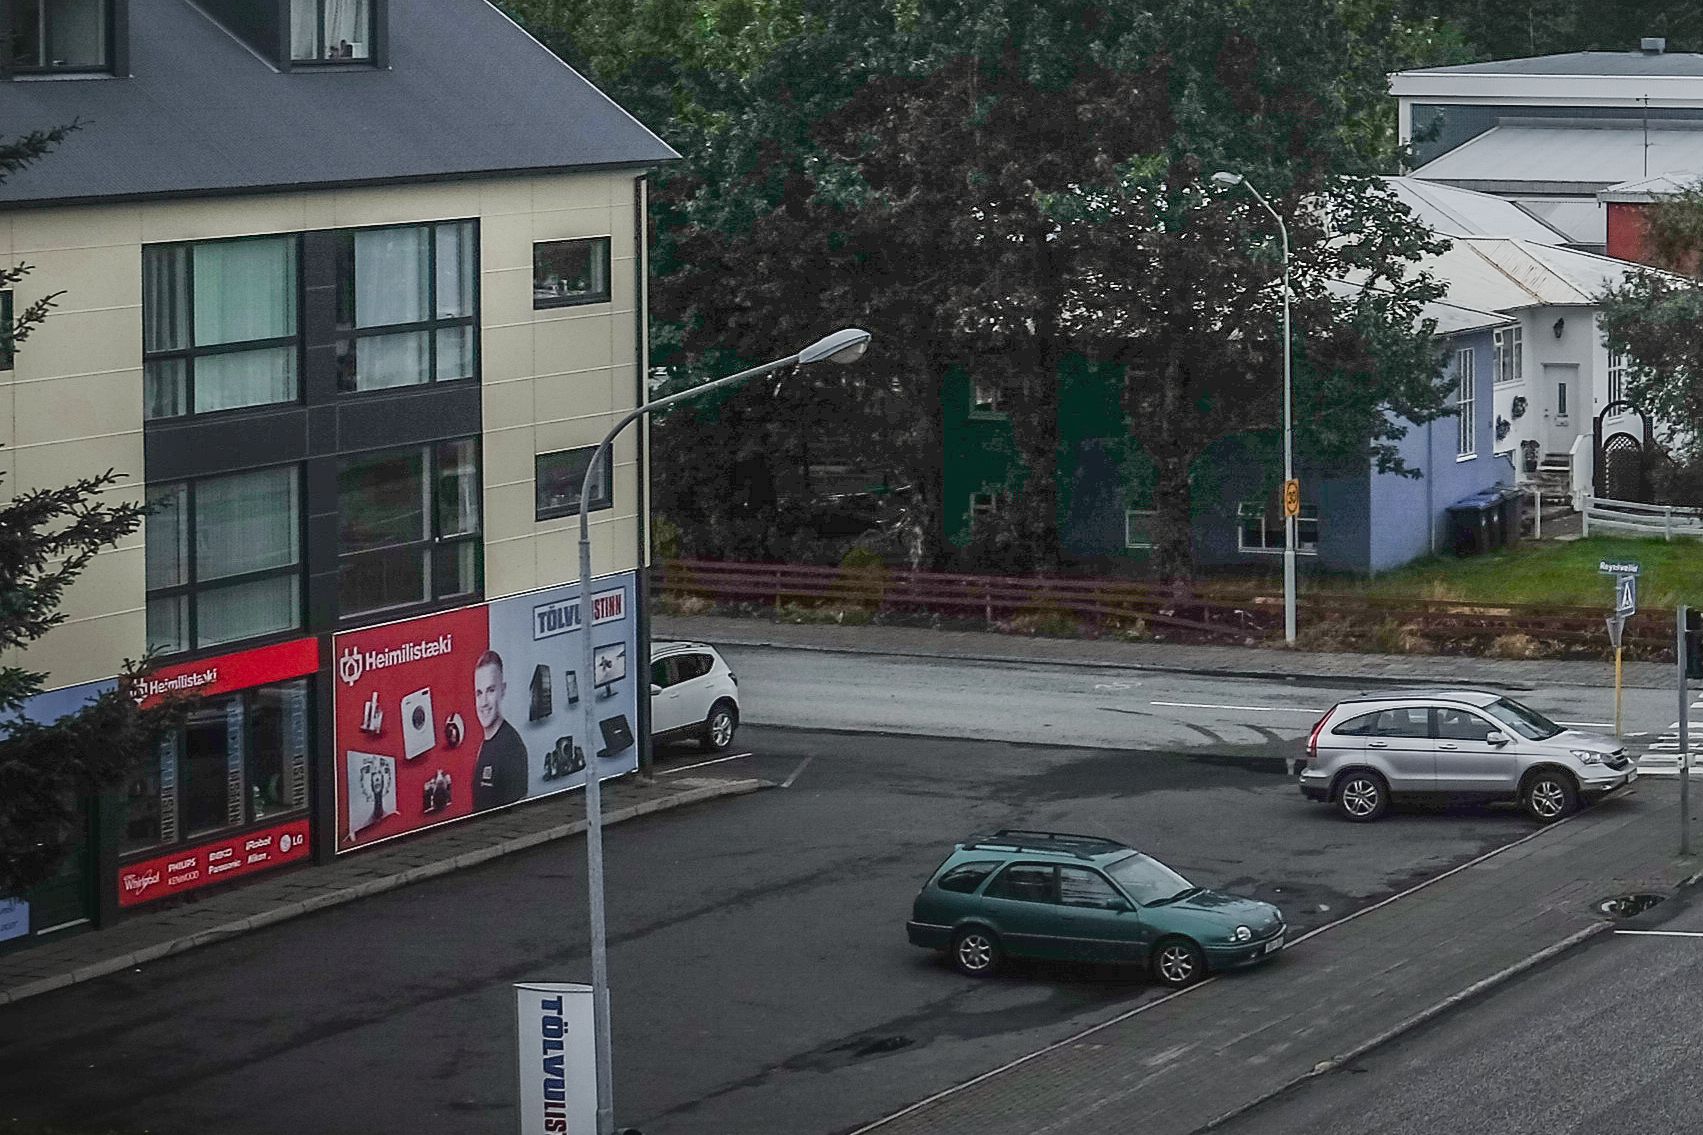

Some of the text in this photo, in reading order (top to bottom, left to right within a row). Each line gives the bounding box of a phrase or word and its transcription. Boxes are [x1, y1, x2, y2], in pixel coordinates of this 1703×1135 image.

[537, 593, 622, 633] TÖLVUSTINN
[365, 634, 452, 671] Heimilistæki
[168, 857, 196, 872] PHILIPS
[168, 870, 200, 885] KENWOOD
[541, 995, 568, 1135] TÖLVULIS
